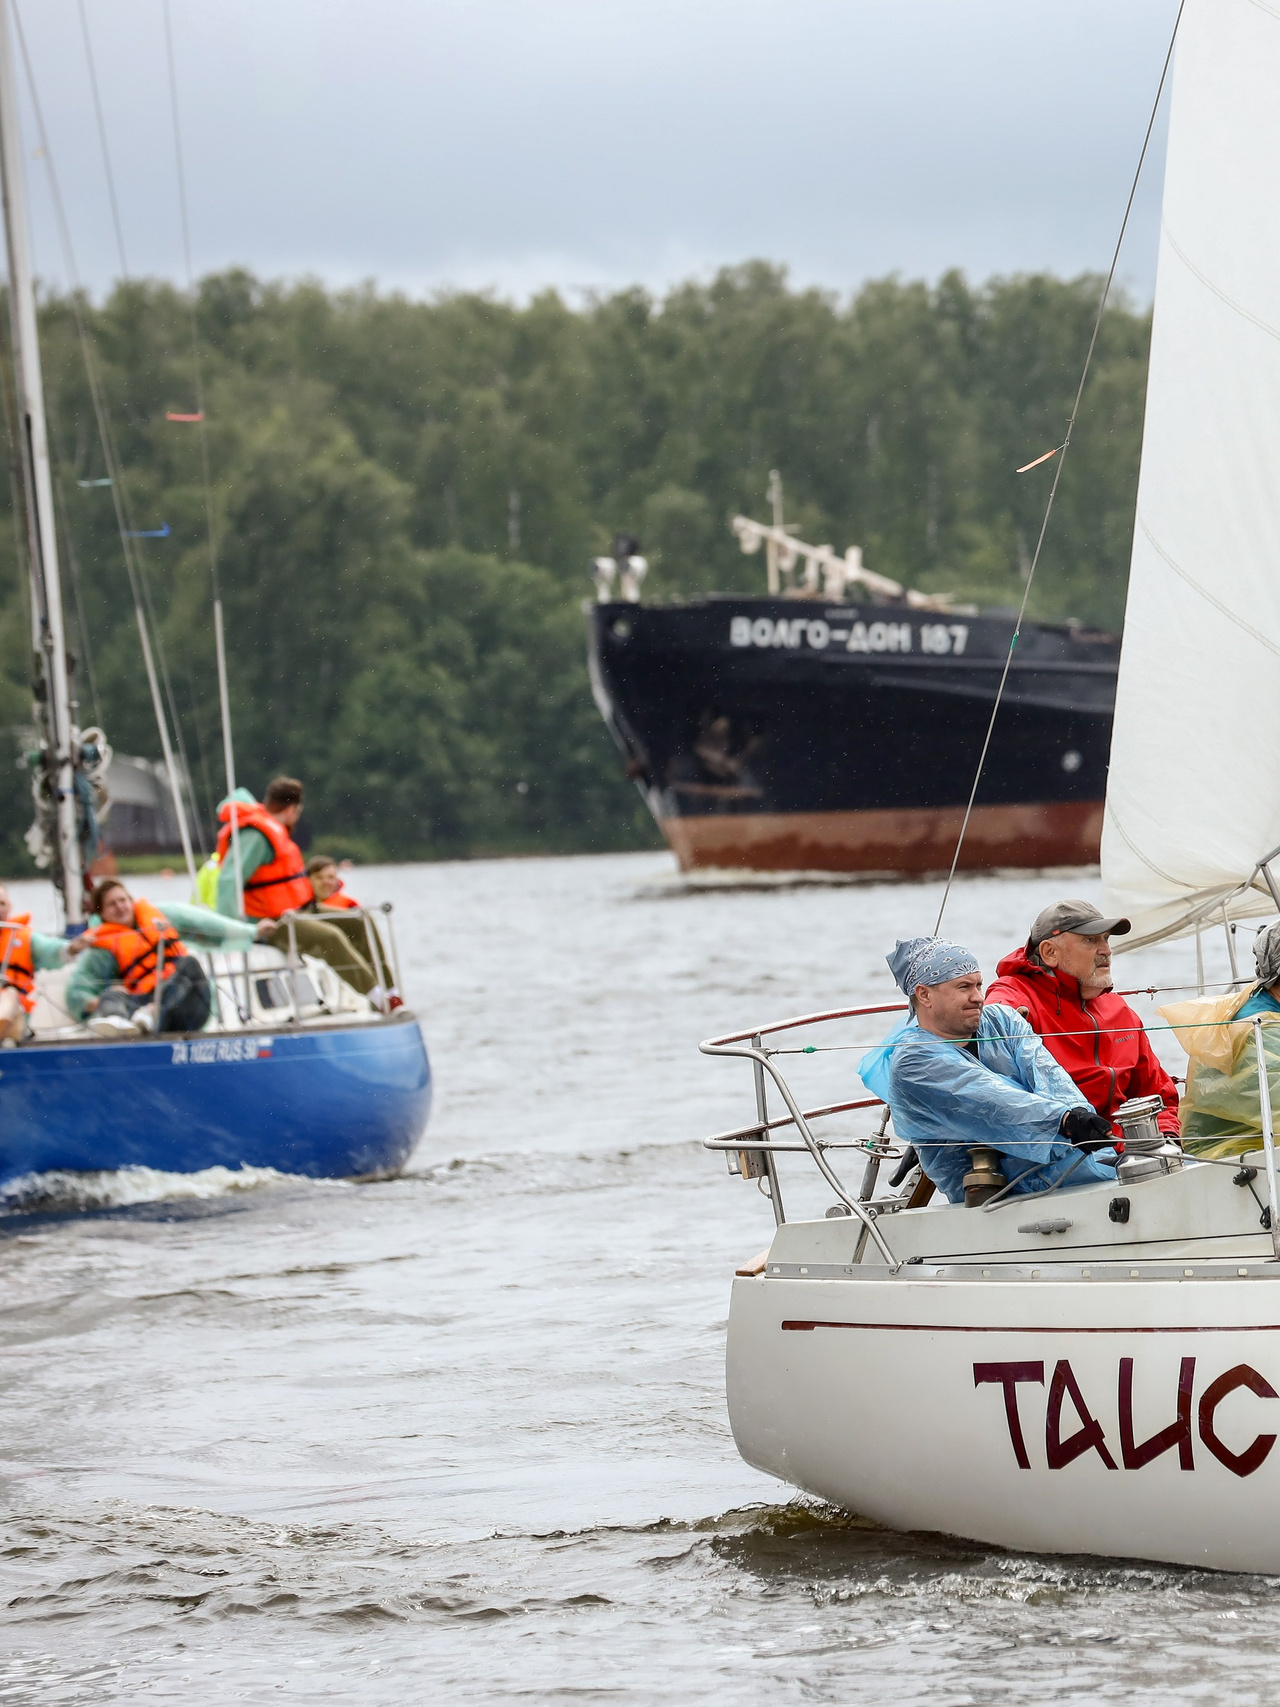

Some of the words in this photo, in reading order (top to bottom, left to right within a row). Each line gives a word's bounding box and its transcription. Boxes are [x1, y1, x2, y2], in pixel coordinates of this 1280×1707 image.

[730, 616, 912, 654] ВОЛГО-ДОН
[920, 623, 969, 655] 187
[972, 1356, 1280, 1478] ТАИС
